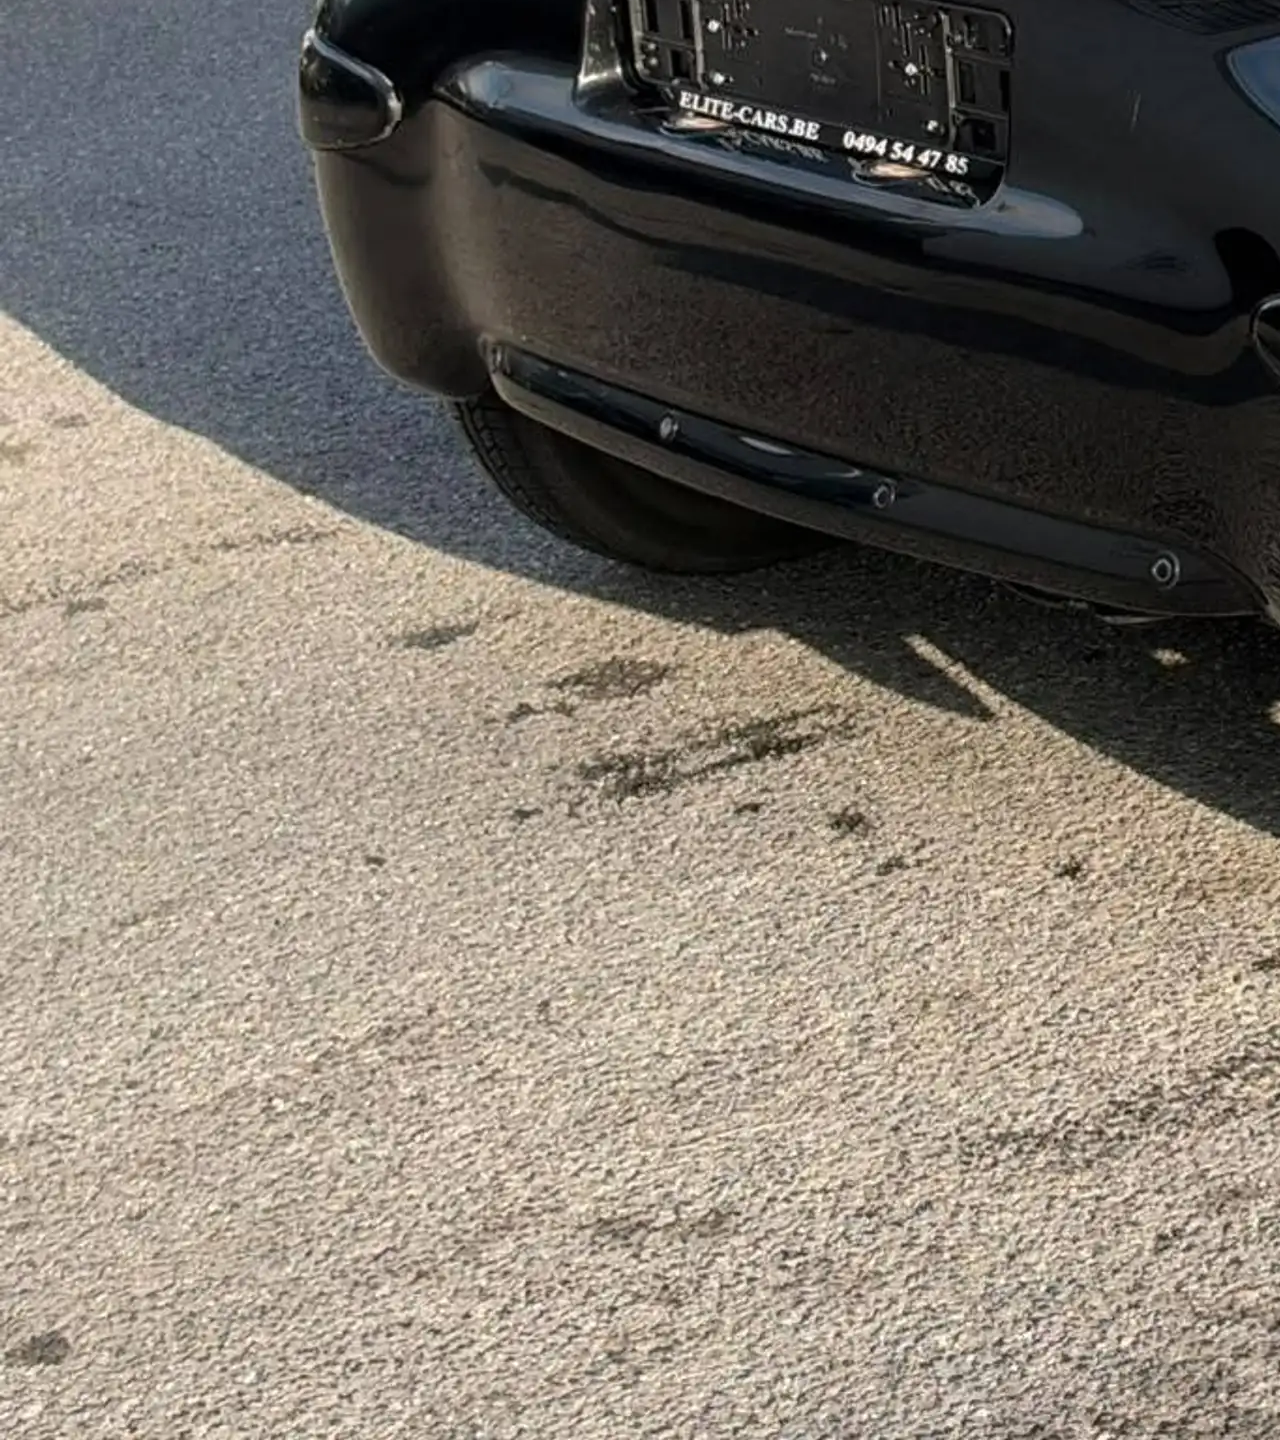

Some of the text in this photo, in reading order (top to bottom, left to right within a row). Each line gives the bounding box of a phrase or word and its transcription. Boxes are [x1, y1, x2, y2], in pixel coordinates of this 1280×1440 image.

[679, 90, 821, 141] ELITE-CARS.BE
[842, 130, 888, 157] 0494
[889, 141, 915, 163] 54
[916, 149, 942, 169] 47
[944, 153, 969, 176] 85
